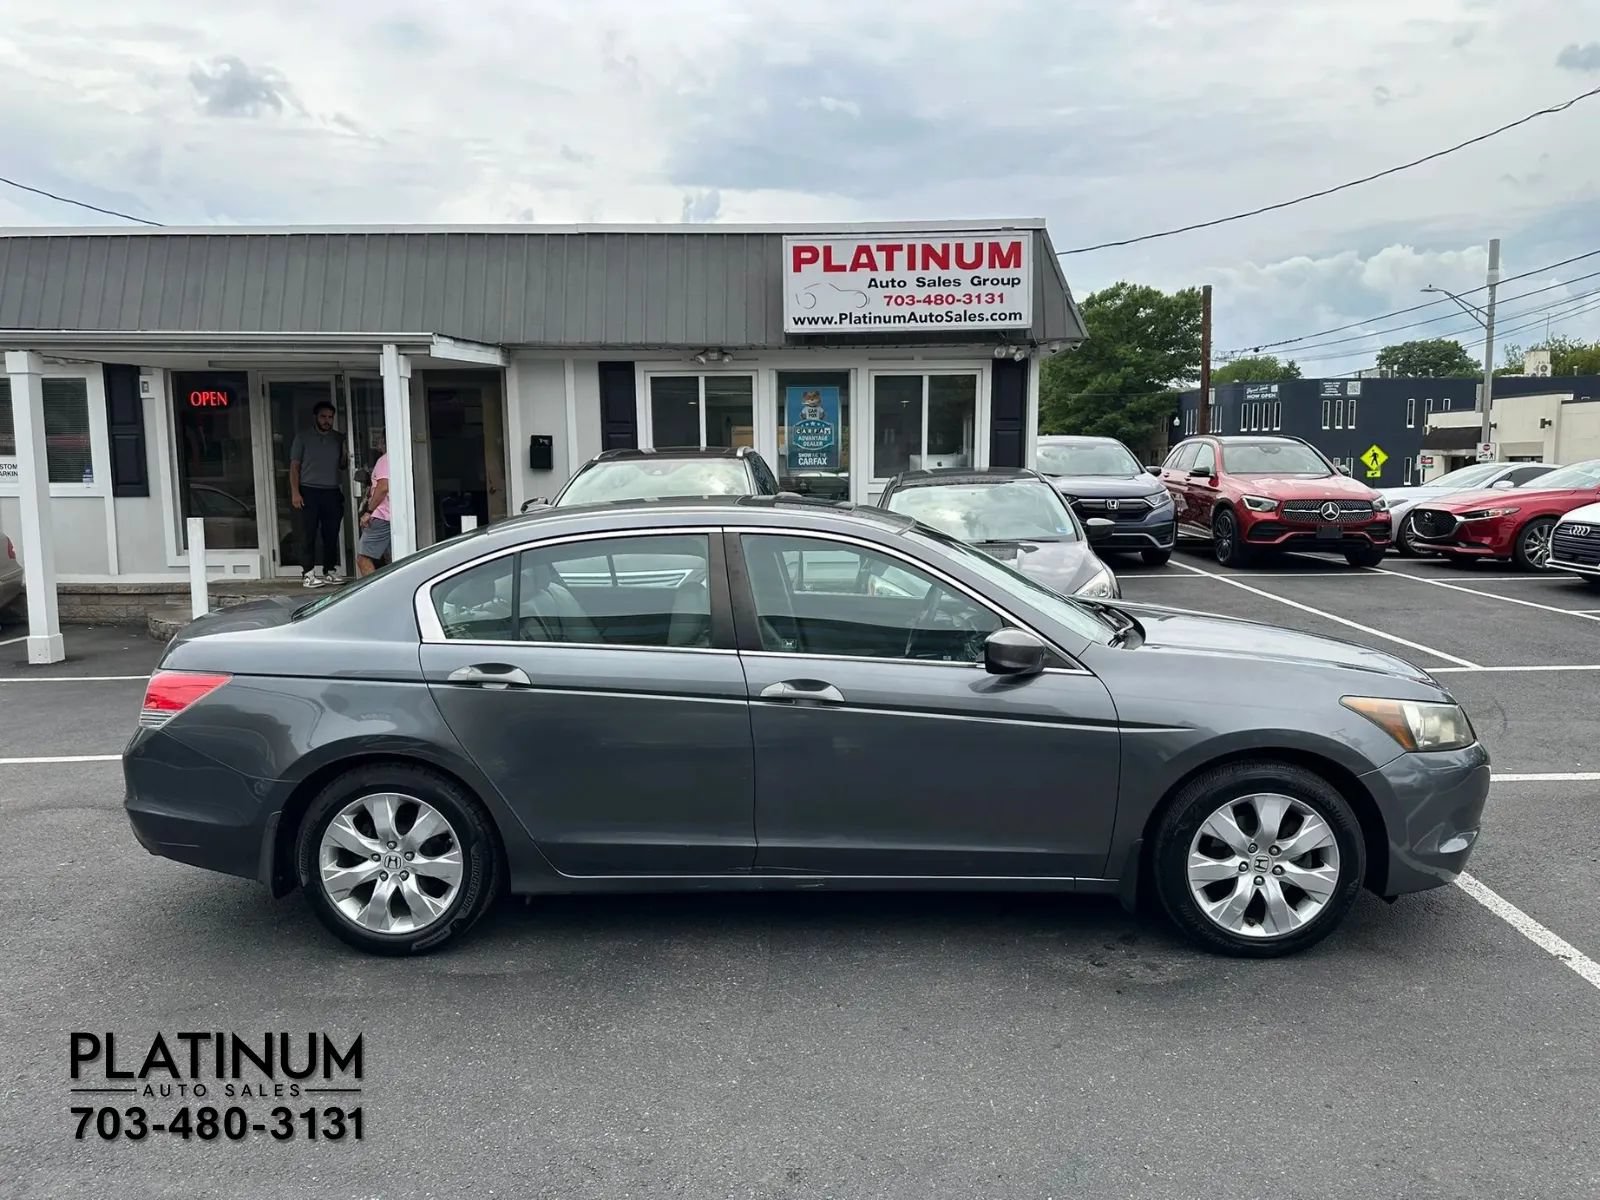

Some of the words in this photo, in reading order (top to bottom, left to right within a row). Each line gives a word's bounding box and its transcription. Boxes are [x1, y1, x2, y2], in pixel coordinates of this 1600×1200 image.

[792, 241, 1022, 273] PLATINUM
[867, 277, 907, 289] Auto
[915, 276, 962, 288] Sales
[970, 275, 1021, 289] Group
[883, 292, 1005, 307] 703-480-3131
[792, 310, 1023, 326] www.PlatinumAutoSales.com
[190, 391, 228, 406] OPEN
[798, 457, 827, 466] CARFAX
